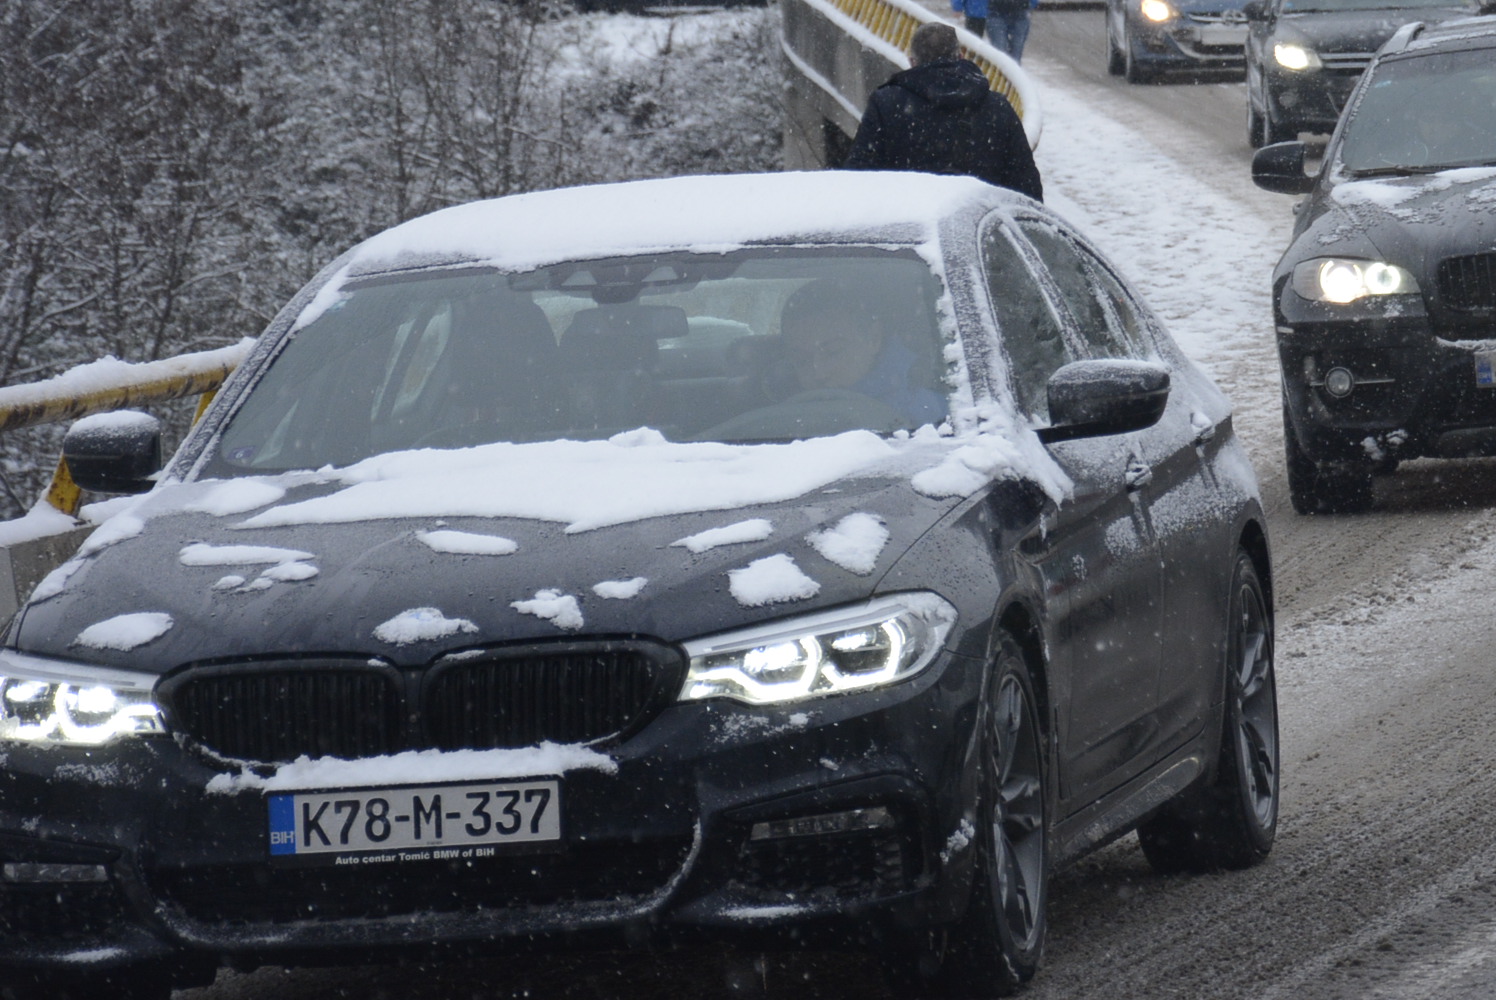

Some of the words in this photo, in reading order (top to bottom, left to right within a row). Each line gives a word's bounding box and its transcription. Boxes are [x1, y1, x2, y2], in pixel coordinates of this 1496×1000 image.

[270, 831, 295, 845] BIH
[302, 787, 552, 847] K78-M-337
[335, 856, 359, 865] Auto
[362, 855, 396, 865] centar
[433, 850, 459, 860] BMW
[462, 849, 473, 858] of
[475, 848, 495, 857] BiH
